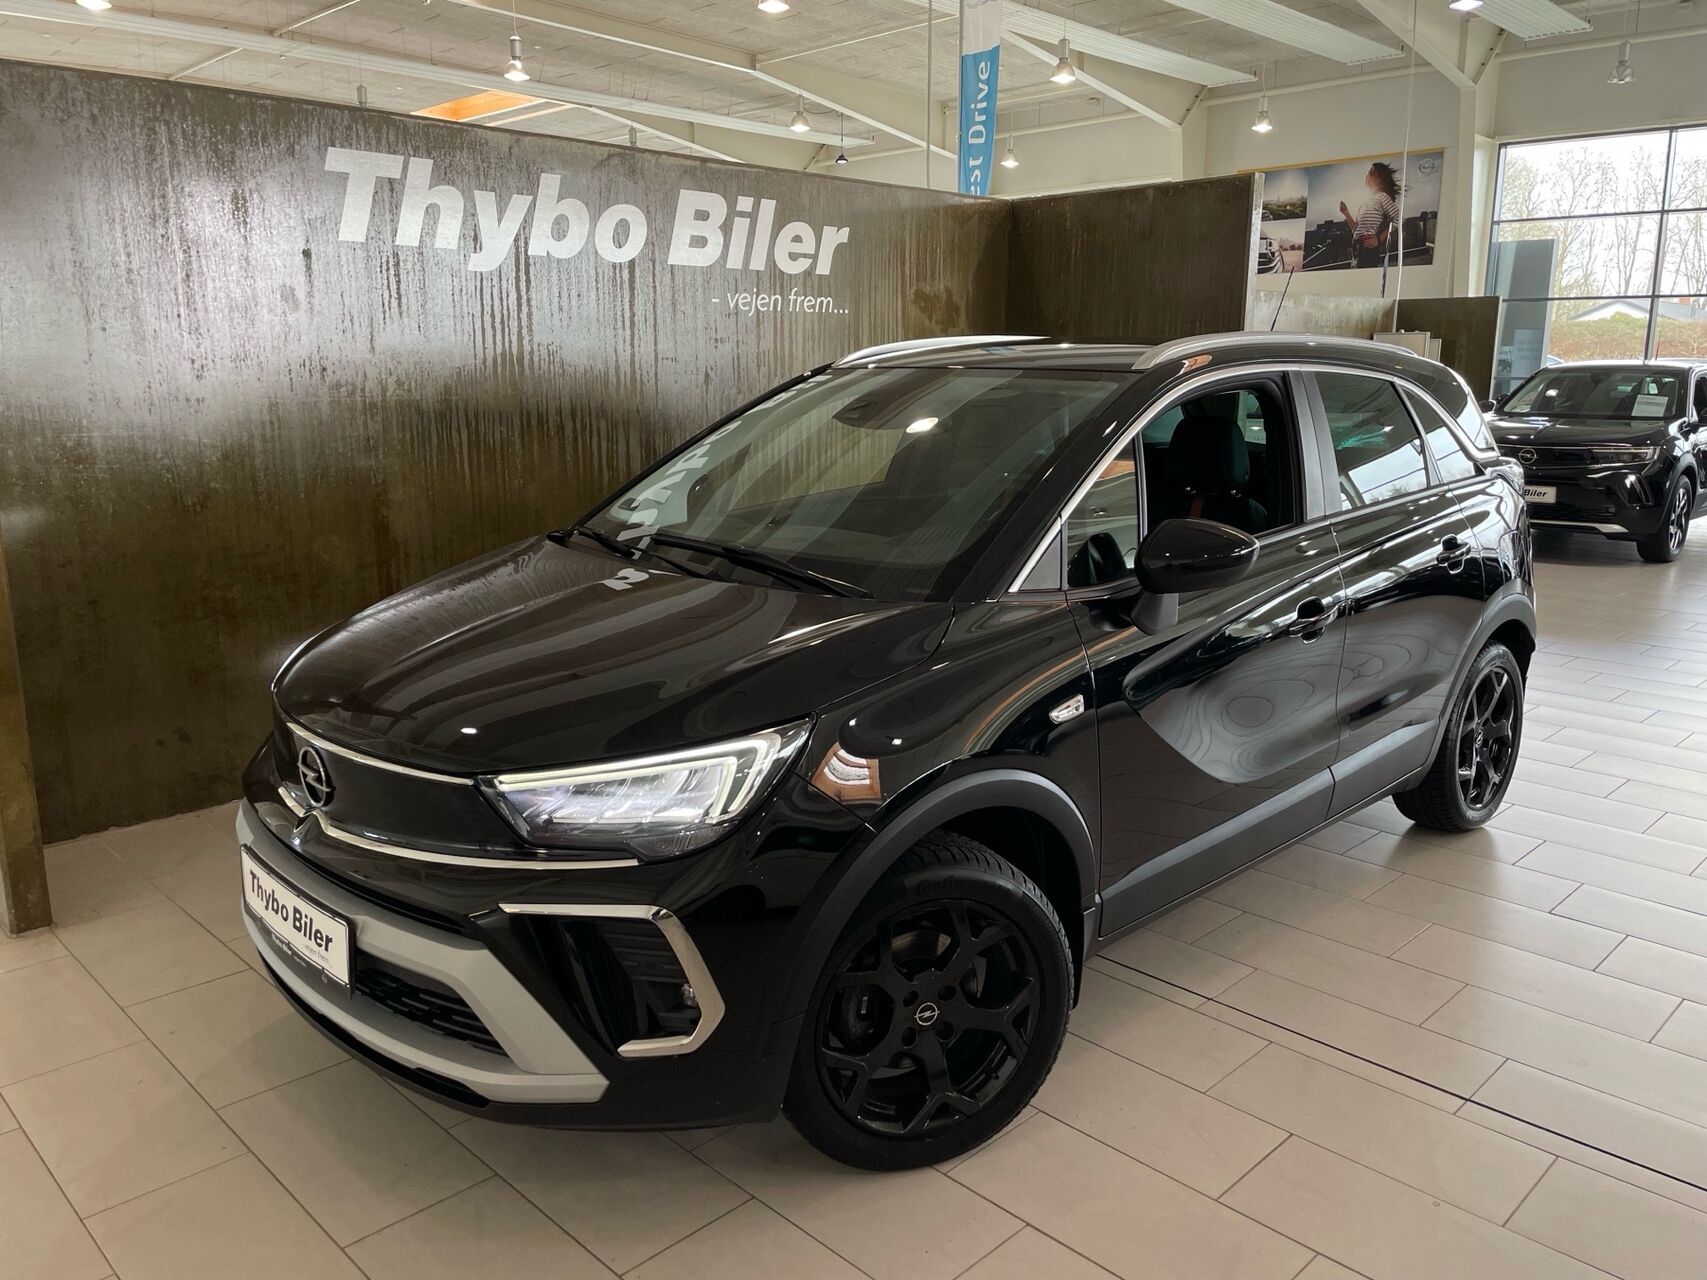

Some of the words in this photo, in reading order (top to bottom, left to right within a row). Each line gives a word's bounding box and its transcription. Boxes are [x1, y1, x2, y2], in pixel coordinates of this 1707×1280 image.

[968, 61, 991, 145] Drive
[324, 146, 648, 273] Thybo
[667, 189, 850, 276] Biler
[727, 287, 782, 317] vejen
[788, 287, 849, 314] frem...
[1524, 489, 1547, 497] Biler
[250, 870, 289, 922] Thybo
[292, 906, 333, 952] Biler
